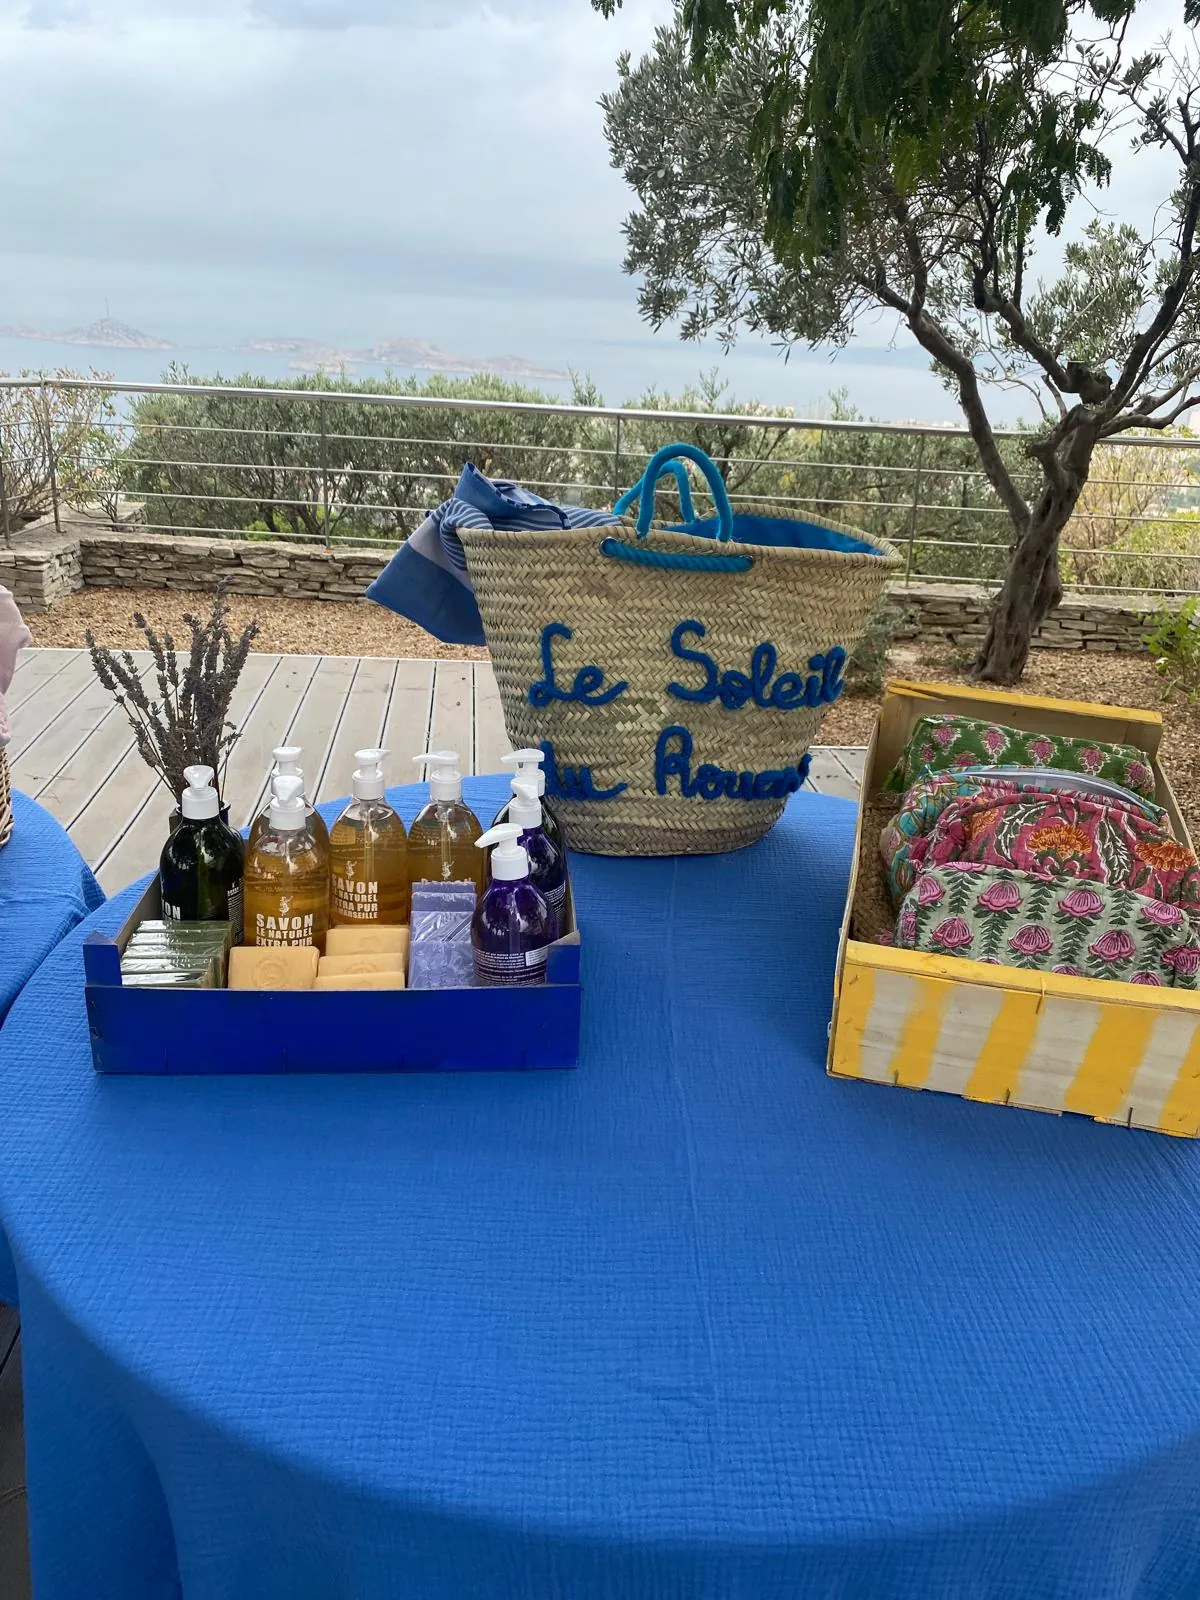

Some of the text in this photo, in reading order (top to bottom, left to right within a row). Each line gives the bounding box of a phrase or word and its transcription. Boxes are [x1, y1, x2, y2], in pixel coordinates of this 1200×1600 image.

[528, 619, 846, 710] Le Soleil
[357, 903, 378, 912] PUR
[256, 913, 313, 930] SAVON
[256, 926, 313, 939] LE NATUREL
[256, 936, 288, 947] EXTRA
